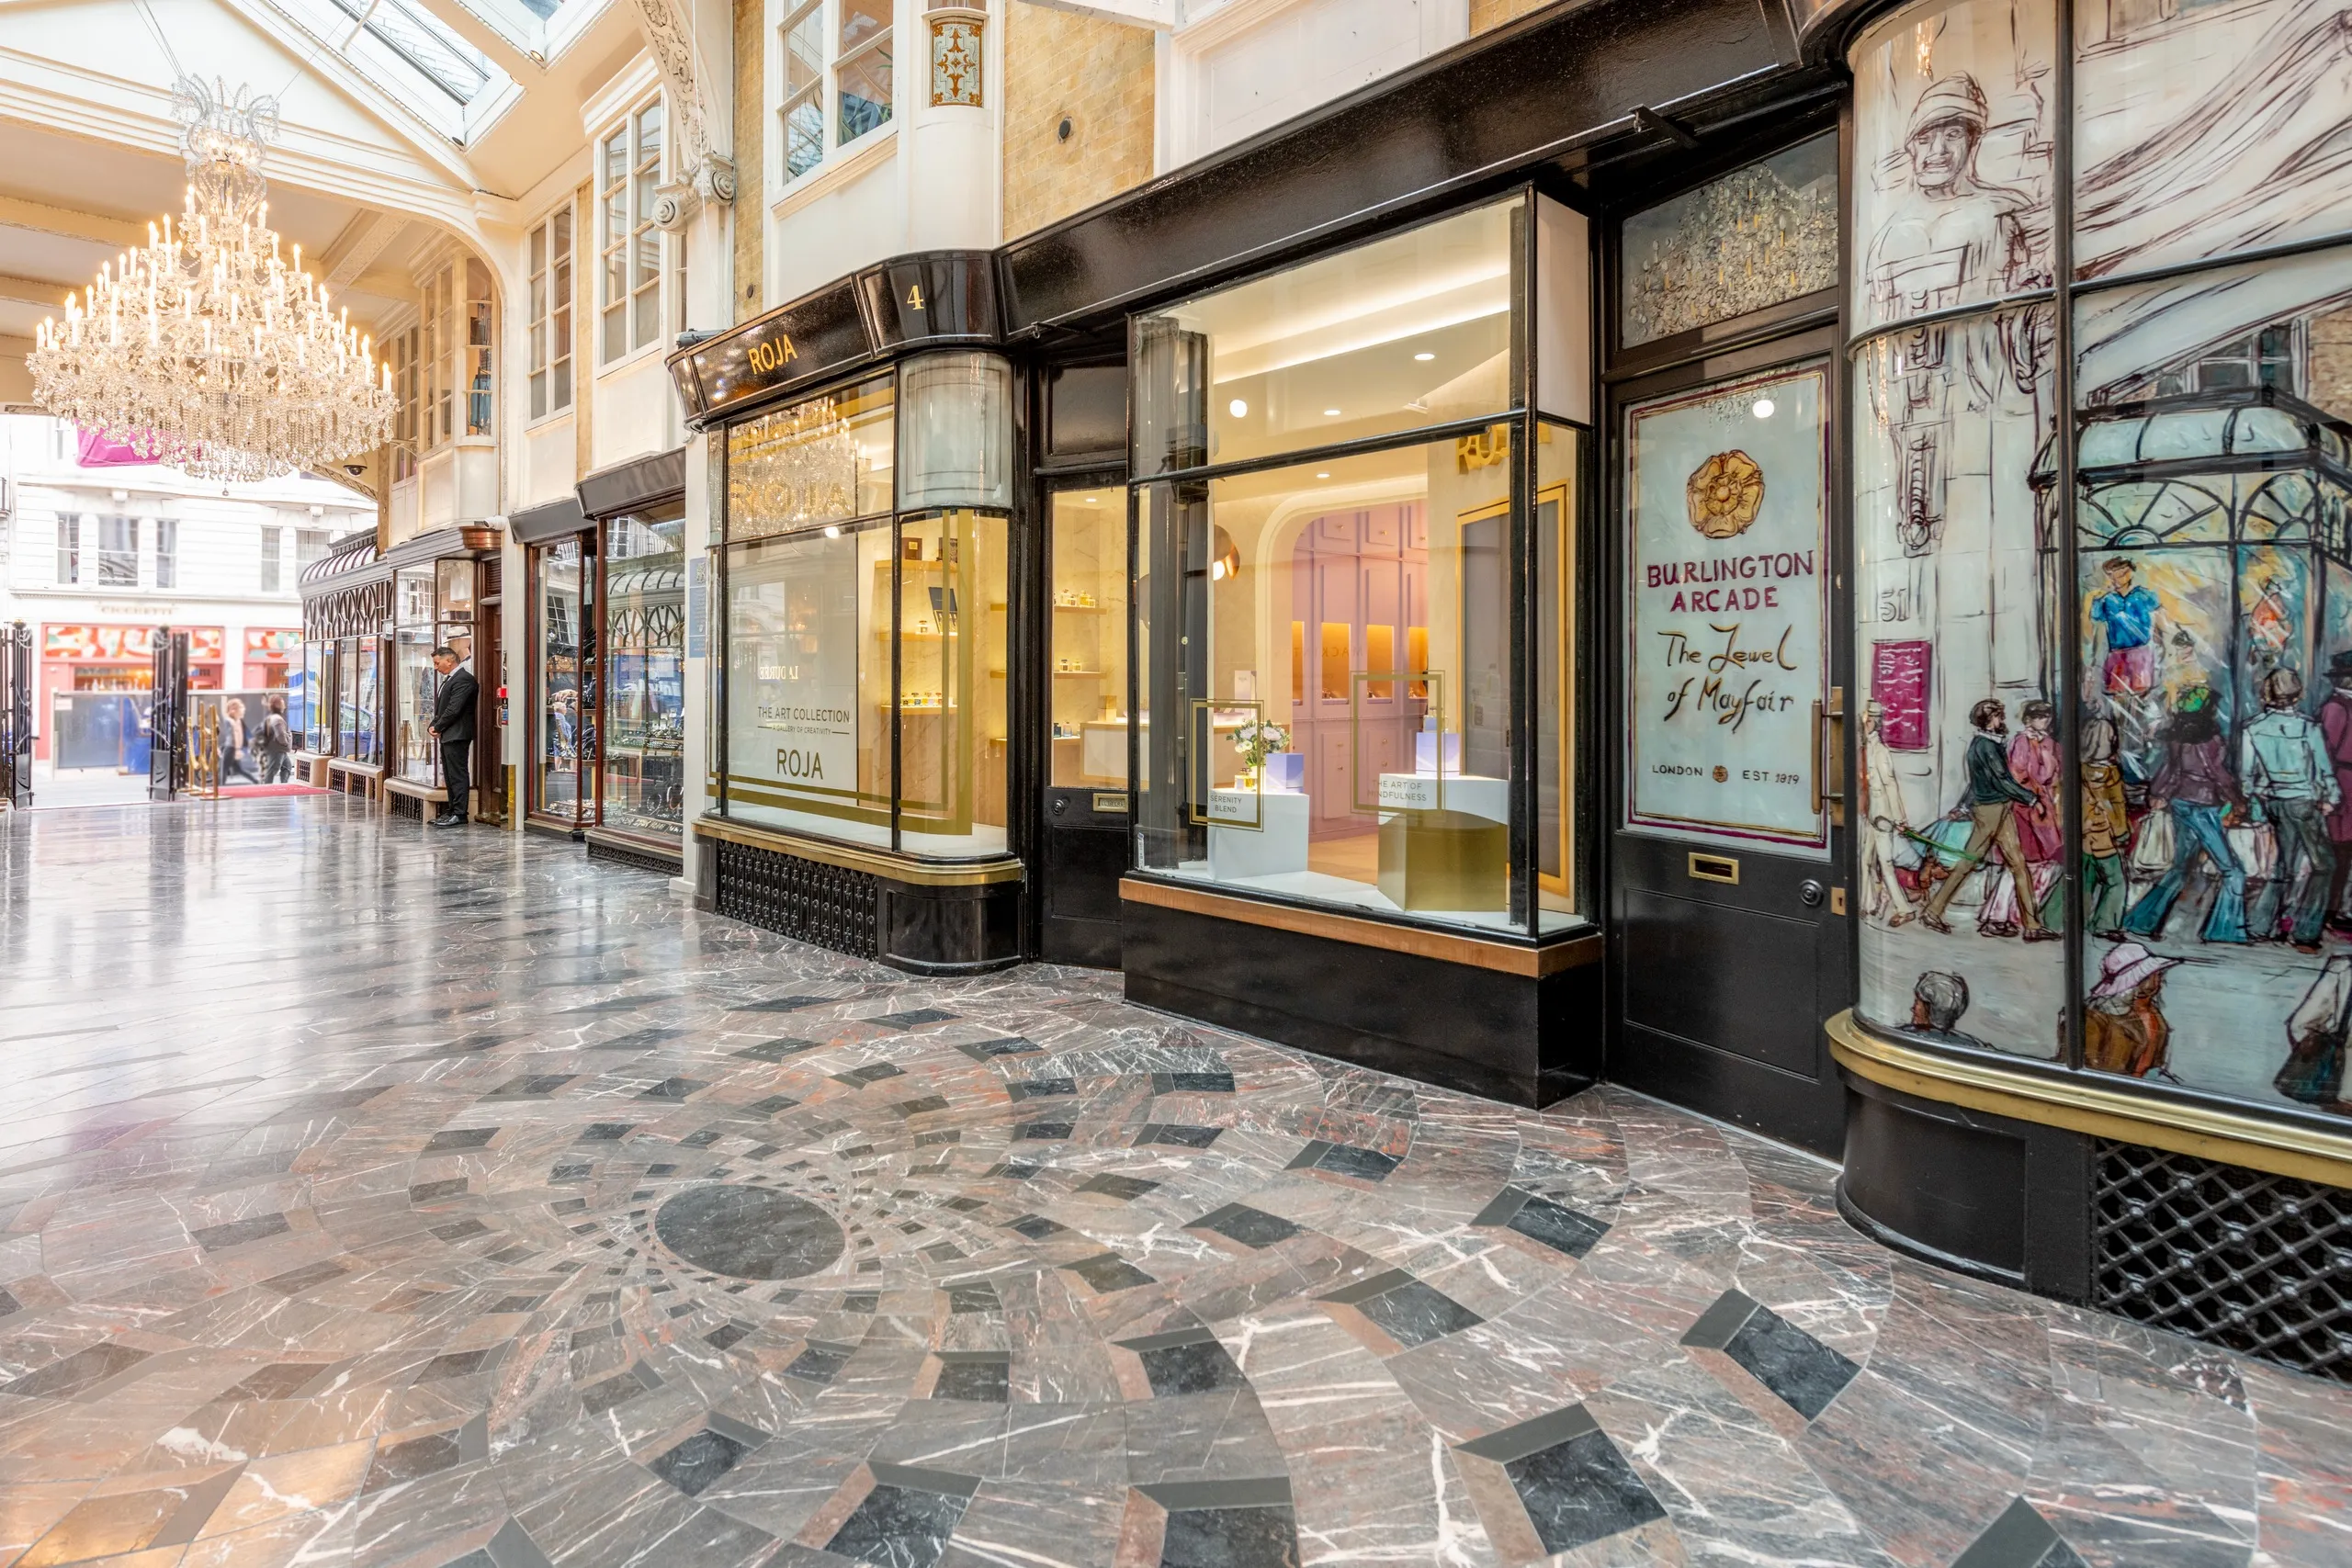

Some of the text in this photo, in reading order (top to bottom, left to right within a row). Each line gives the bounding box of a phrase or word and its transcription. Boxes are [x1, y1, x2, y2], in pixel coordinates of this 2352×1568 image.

[906, 285, 925, 310] 4
[747, 333, 798, 375] ROJA
[1647, 550, 1815, 588] BURLINGTON
[1670, 585, 1779, 613] ARCADE
[1657, 623, 1798, 674] The Jewel
[758, 706, 850, 723] THE ART COLLECTION
[1664, 676, 1794, 734] of Mayfair
[804, 727, 831, 735] CREATIVITY
[776, 749, 823, 780] ROJA
[1652, 764, 1800, 784] LONDON EST 1819
[1367, 790, 1427, 801] MINDFULNESS
[1372, 780, 1388, 788] THE
[1391, 781, 1408, 789] ART
[1210, 795, 1242, 805] SERENITY
[1215, 805, 1238, 813] BLEND
